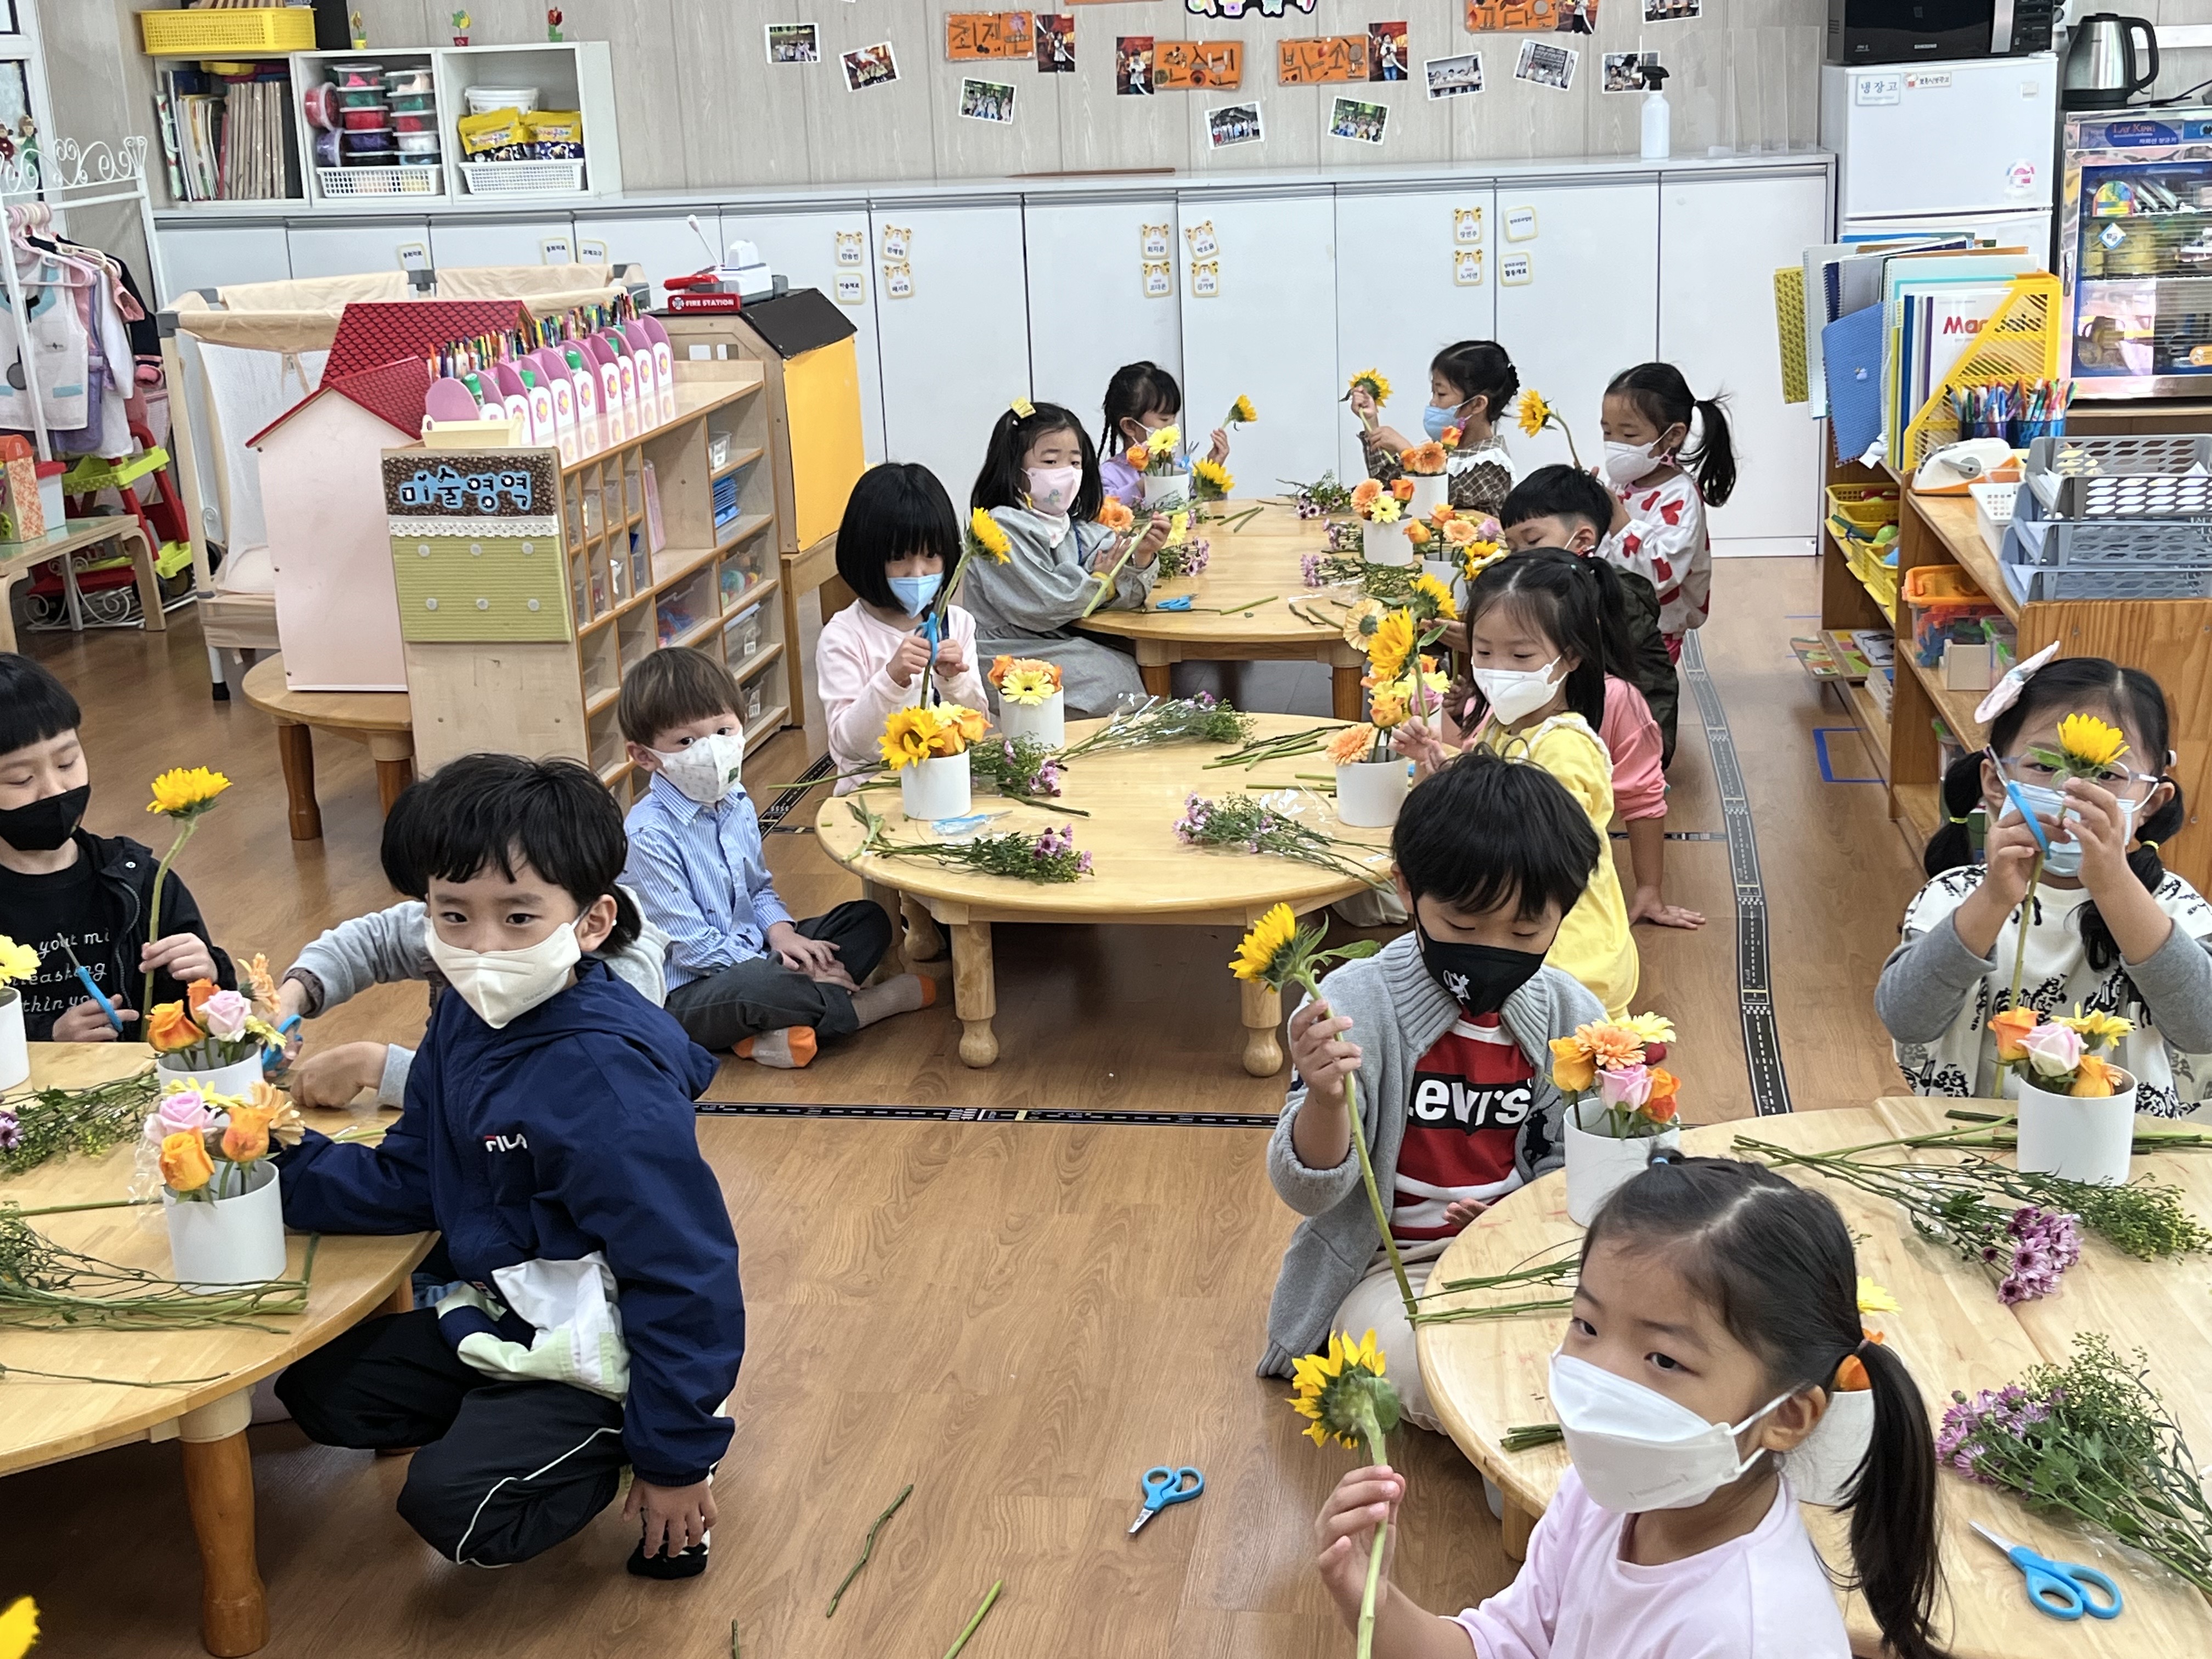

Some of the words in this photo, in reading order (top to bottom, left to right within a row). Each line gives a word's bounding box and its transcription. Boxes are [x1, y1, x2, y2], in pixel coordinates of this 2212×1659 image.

[1861, 81, 1898, 93] 냉장고
[401, 467, 527, 509] 미술영역
[483, 1133, 528, 1152] FILA
